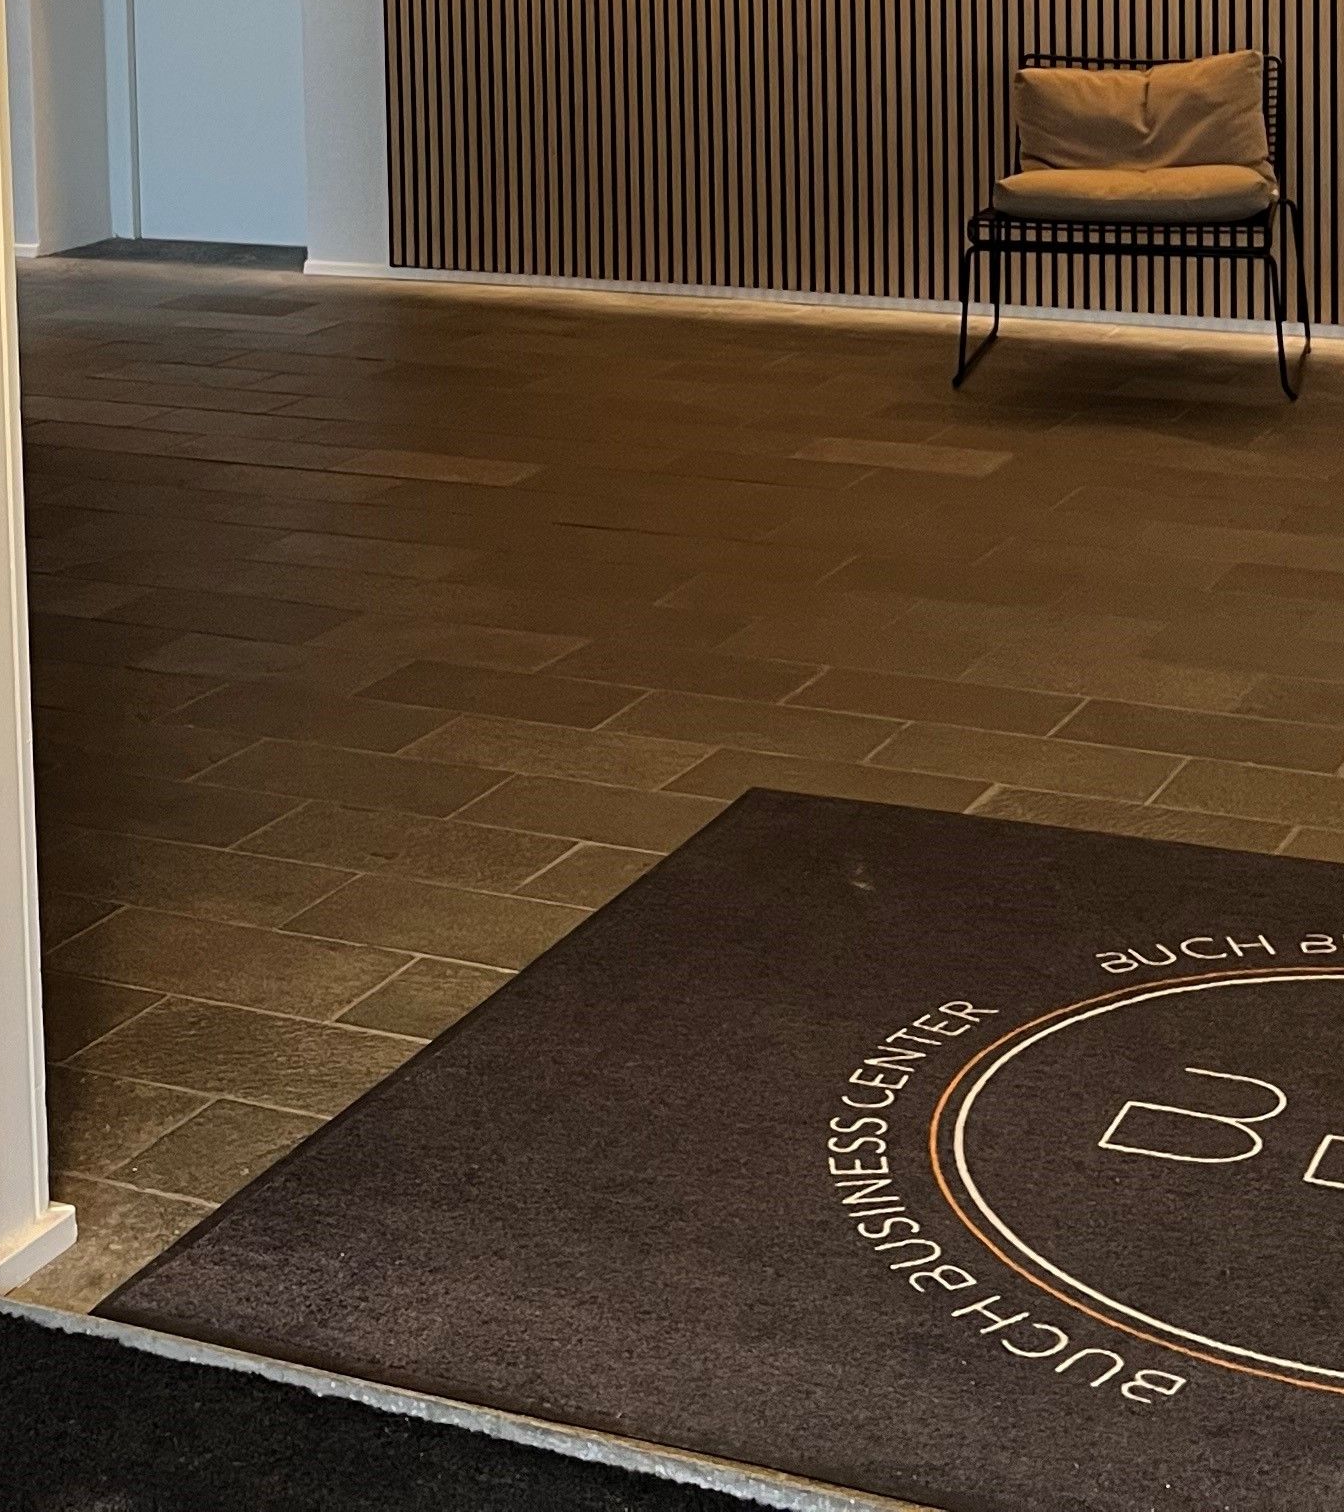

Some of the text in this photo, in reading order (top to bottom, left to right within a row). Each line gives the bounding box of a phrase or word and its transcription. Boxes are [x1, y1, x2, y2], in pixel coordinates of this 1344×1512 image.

[1095, 933, 1276, 975] BUCH
[827, 999, 1188, 1405] BUCH BUSINESS CENTER
